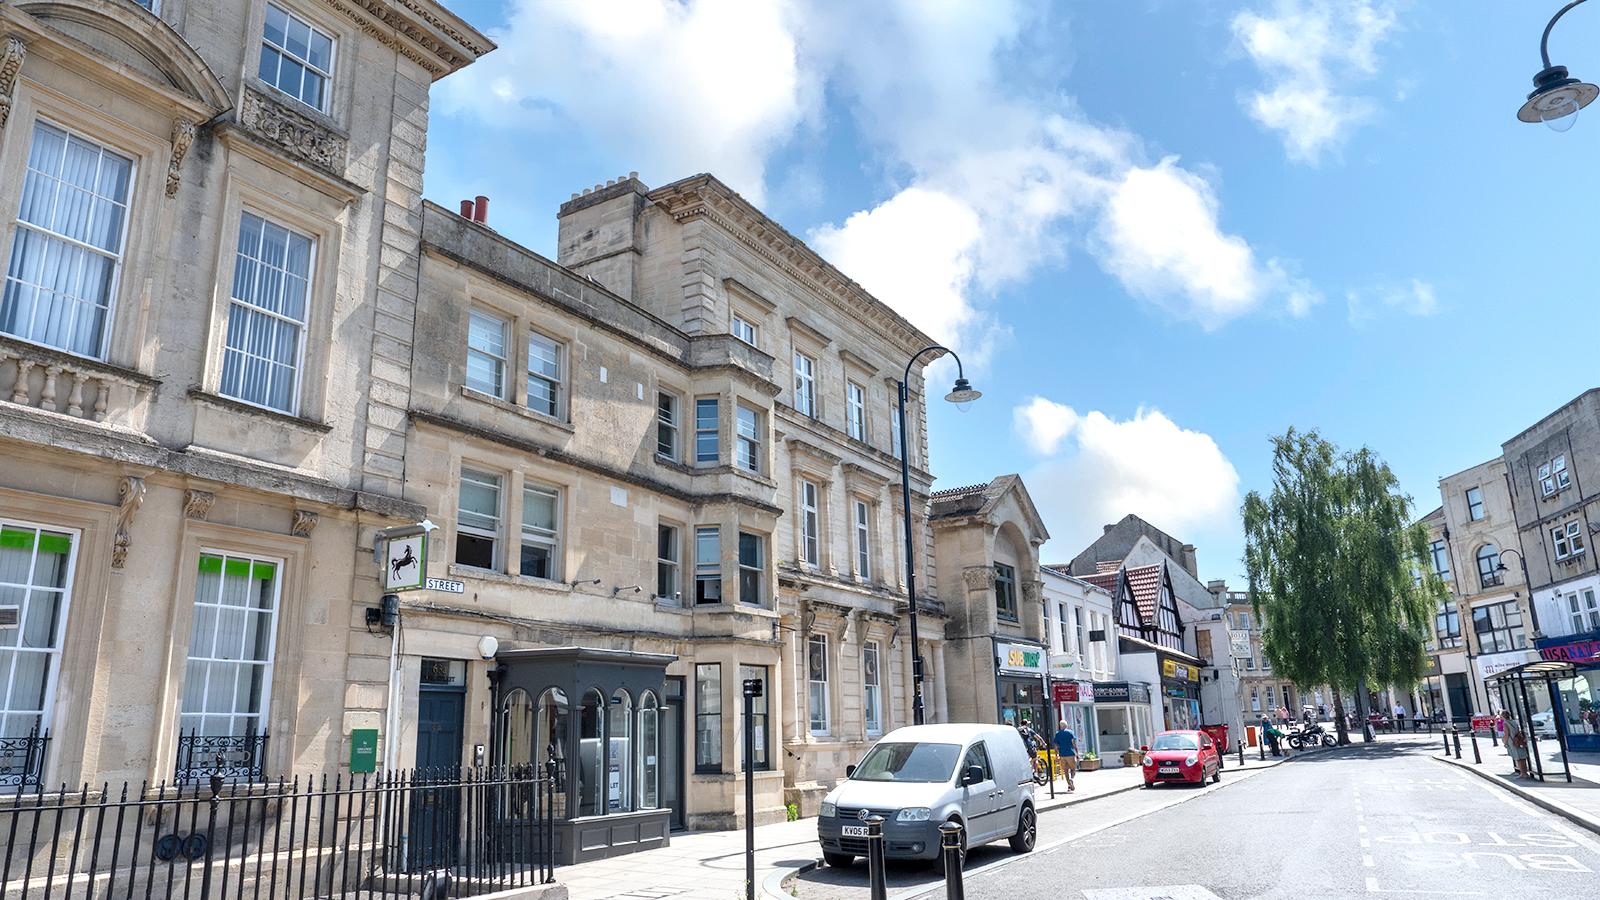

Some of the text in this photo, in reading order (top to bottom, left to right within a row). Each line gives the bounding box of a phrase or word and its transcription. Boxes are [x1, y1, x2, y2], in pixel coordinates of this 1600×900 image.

[428, 579, 461, 592] STREET
[1008, 648, 1041, 668] SUBWAY
[1543, 648, 1570, 661] USA
[844, 826, 862, 836] KV05
[1375, 831, 1580, 848] STOP
